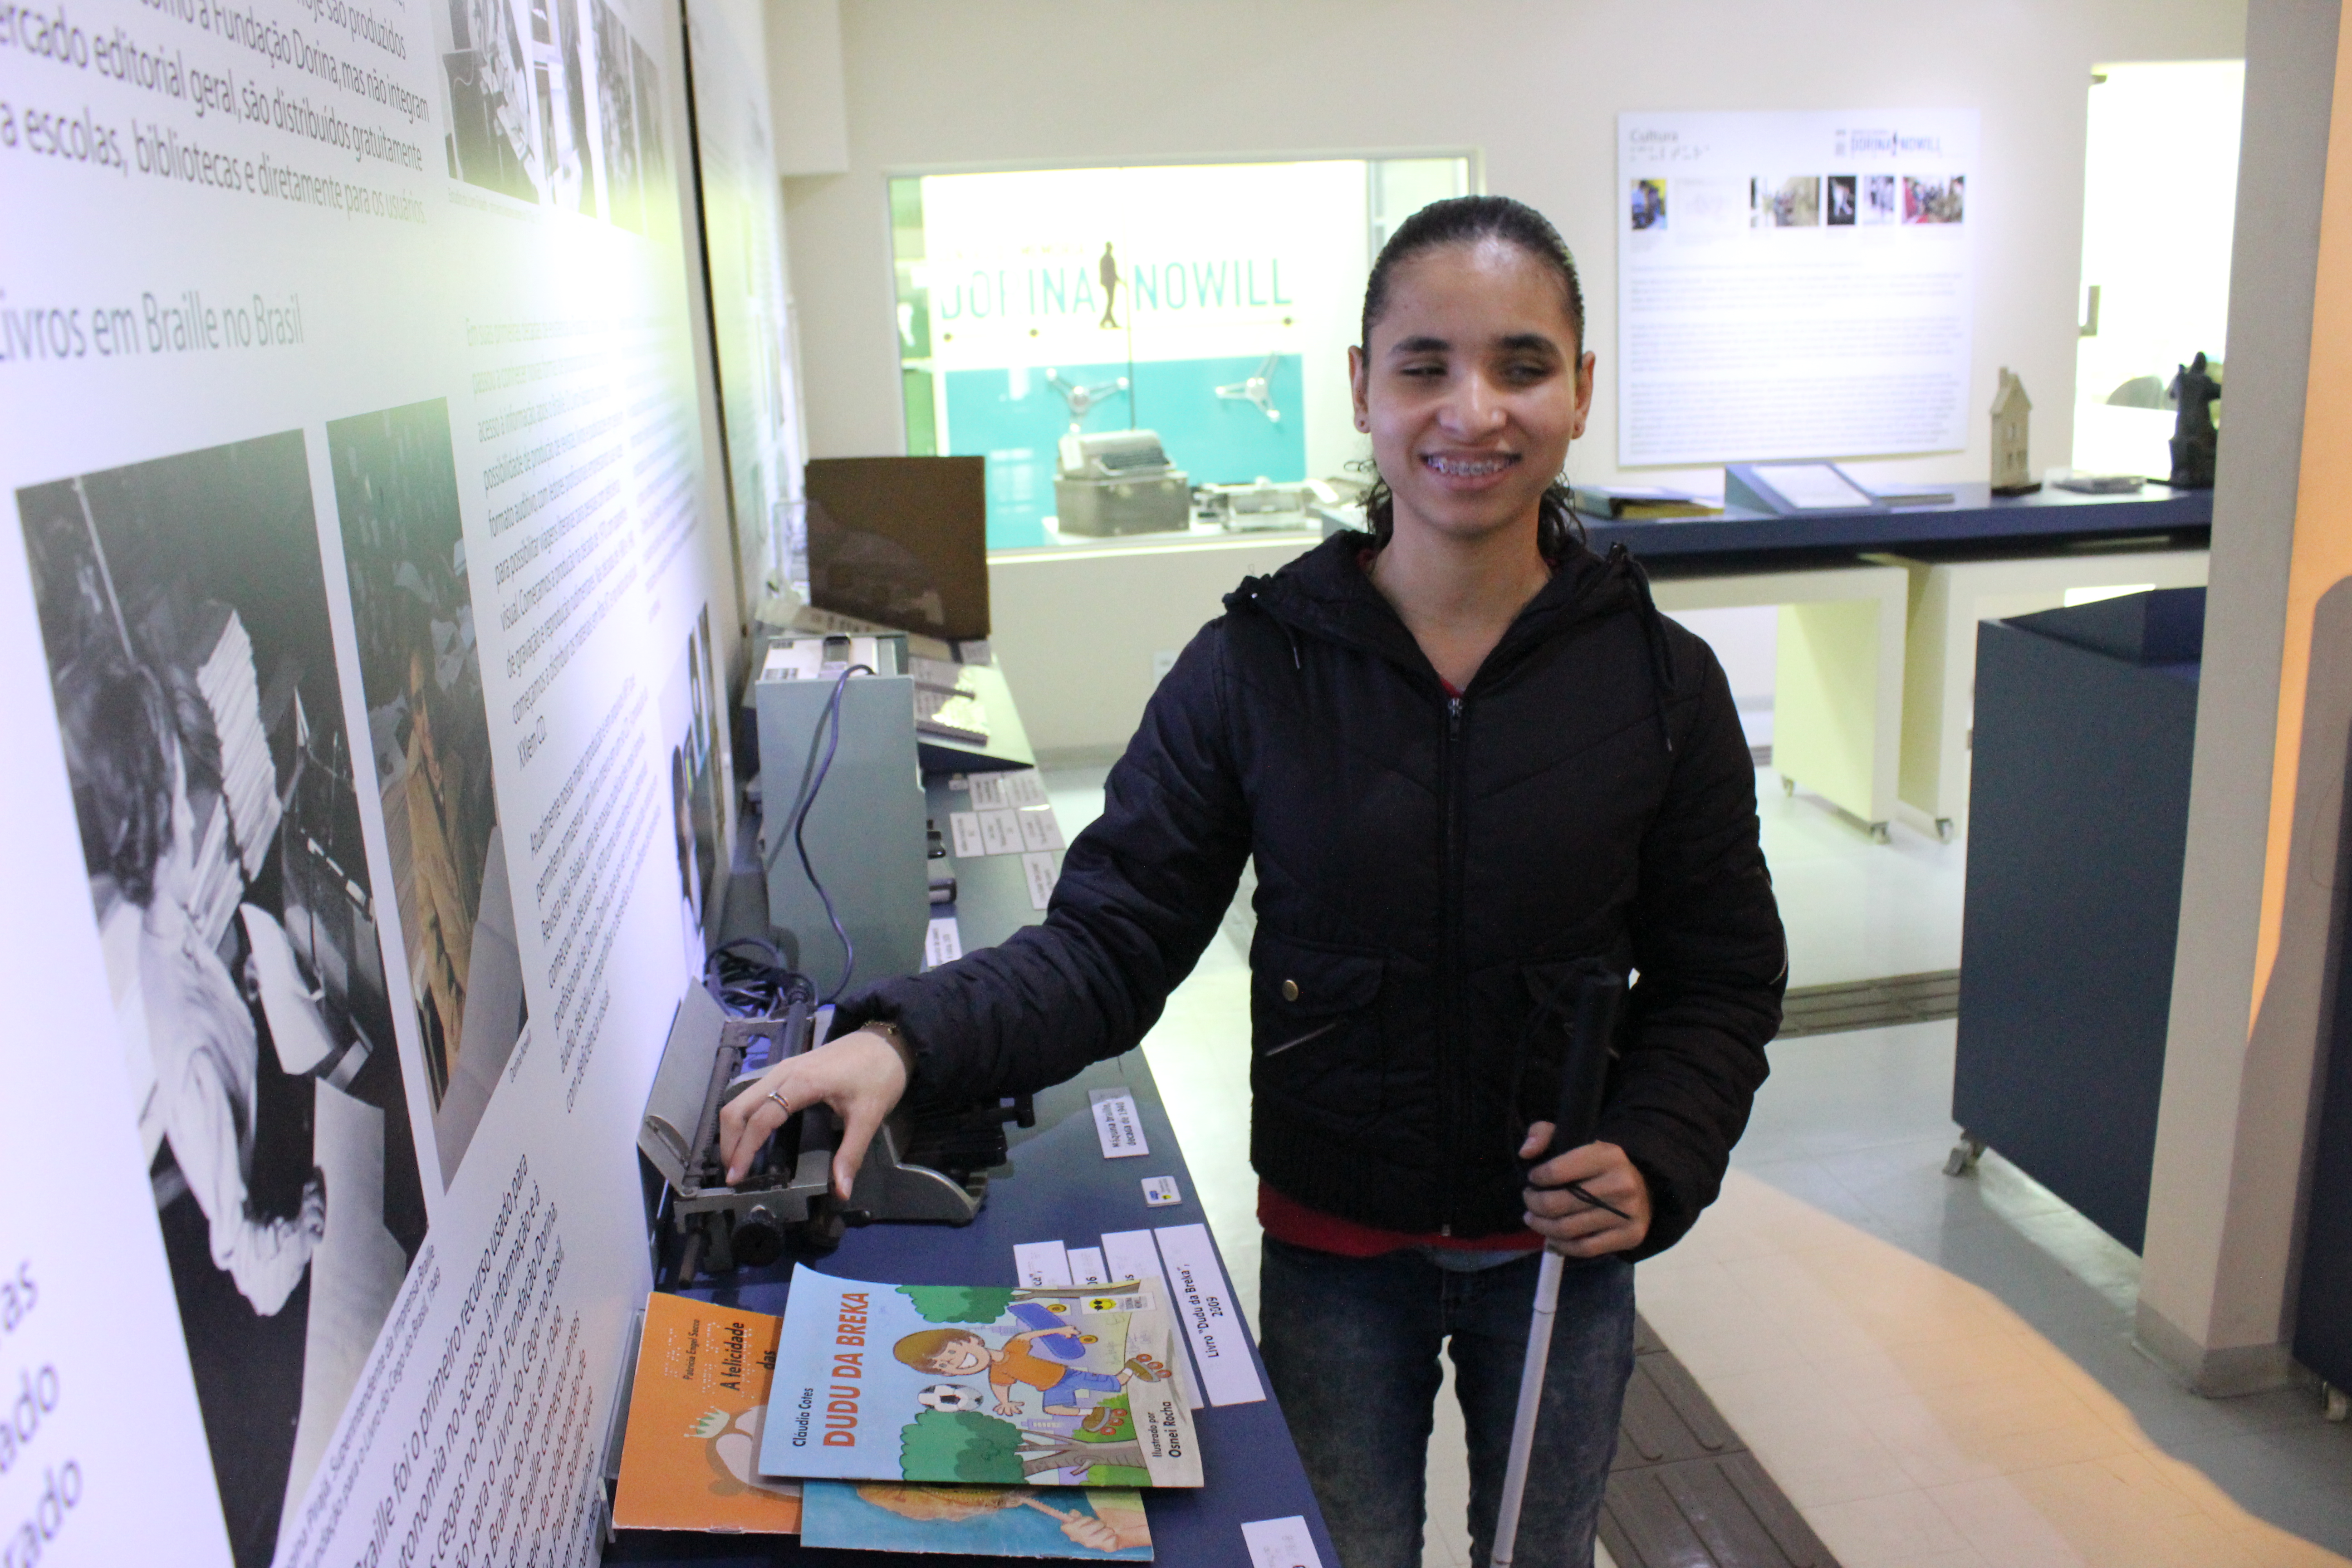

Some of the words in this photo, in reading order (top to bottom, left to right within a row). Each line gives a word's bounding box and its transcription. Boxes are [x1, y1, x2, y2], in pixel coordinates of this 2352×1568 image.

[348, 7, 407, 61] produzidos
[200, 8, 211, 30] a
[212, 0, 292, 69] Fundação
[293, 28, 342, 91] Dorina,
[342, 61, 366, 96] mas
[366, 68, 387, 106] não
[387, 73, 430, 125] integram
[93, 26, 187, 100] editorial
[190, 69, 241, 124] geral,
[242, 79, 270, 125] são
[273, 87, 350, 150] distribuídos
[352, 126, 423, 172] gratuitamente
[1630, 129, 1679, 143] Cultura
[26, 106, 128, 177] escolas,
[132, 118, 241, 191] bibliotecas
[244, 161, 255, 194] e
[259, 152, 343, 209] diretamente
[344, 183, 370, 221] para
[372, 189, 385, 217] os
[1134, 257, 1293, 311] NOWILL
[91, 308, 141, 357] em
[142, 291, 220, 353] Braille
[223, 308, 251, 348] no
[253, 293, 304, 346] Brasil
[488, 507, 514, 537] formato
[495, 559, 510, 593] para
[510, 537, 539, 575] possibilitar
[500, 603, 520, 632] visual.
[519, 573, 551, 615] Começamos
[506, 650, 516, 679] de
[515, 627, 540, 677] gravação
[540, 625, 545, 644] e
[512, 672, 546, 724] começamos
[530, 798, 561, 859] Atualmente
[536, 846, 560, 908] permitem
[541, 900, 561, 945] Revista
[560, 879, 571, 909] Veja
[548, 936, 571, 989] começou
[570, 916, 578, 935] na
[554, 962, 581, 1037] profissional
[510, 1053, 522, 1083] Dorina
[560, 1029, 576, 1073] áudio,
[566, 1076, 576, 1114] com
[577, 1016, 599, 1084] deficiência
[418, 1245, 435, 1284] Braille
[427, 1266, 440, 1300] 1949
[445, 1407, 459, 1452] no
[459, 1331, 487, 1415] acesso
[485, 1308, 494, 1339] à
[491, 1210, 530, 1321] informação
[529, 1196, 535, 1218] e
[533, 1179, 540, 1206] à
[835, 1293, 870, 1348] BREKA
[1188, 1294, 1200, 1305] da
[1206, 1296, 1224, 1317] 2009
[393, 1443, 411, 1502] foi
[411, 1431, 420, 1460] o
[420, 1326, 461, 1447] primeiro
[460, 1248, 490, 1333] recurso
[490, 1192, 512, 1256] usado
[511, 1153, 528, 1208] para
[686, 1338, 700, 1355] Engel
[688, 1319, 700, 1338] Secco
[720, 1322, 745, 1378] felicidade
[1204, 1335, 1219, 1358] Livro
[438, 1473, 465, 1565] cegas
[464, 1437, 477, 1481] no
[475, 1363, 500, 1444] Brasil.
[499, 1345, 507, 1379] A
[504, 1258, 537, 1357] Fundação
[534, 1202, 557, 1265] Dorina,
[720, 1381, 741, 1391] A
[755, 1350, 777, 1371] das
[832, 1352, 864, 1379] DA
[469, 1480, 489, 1546] para
[488, 1460, 495, 1486] o
[493, 1401, 514, 1466] Livro
[513, 1369, 523, 1406] do
[522, 1317, 539, 1373] Cego
[539, 1289, 548, 1323] no
[546, 1235, 564, 1297] Brasil,
[798, 1387, 814, 1410] Cotes
[823, 1384, 861, 1447] DUDU
[1147, 1411, 1159, 1423] por
[1160, 1401, 1176, 1426] Rocha
[489, 1474, 514, 1555] Braille
[513, 1441, 524, 1480] do
[523, 1393, 539, 1454] país,
[537, 1357, 549, 1398] em
[546, 1305, 563, 1361] 1949.
[510, 1523, 522, 1568] em
[520, 1451, 541, 1527] Braille
[541, 1359, 566, 1455] começou
[565, 1310, 579, 1366] antes
[540, 1494, 549, 1530] da
[548, 1375, 579, 1498] colaboração
[578, 1349, 586, 1380] de
[792, 1411, 810, 1447] Cláudia
[1148, 1425, 1162, 1458] Ilustrado
[1164, 1429, 1182, 1458] Osnei
[552, 1485, 569, 1549] Pauta
[567, 1423, 584, 1490] Braille
[583, 1385, 593, 1428] que
[571, 1443, 594, 1543] máquinas
